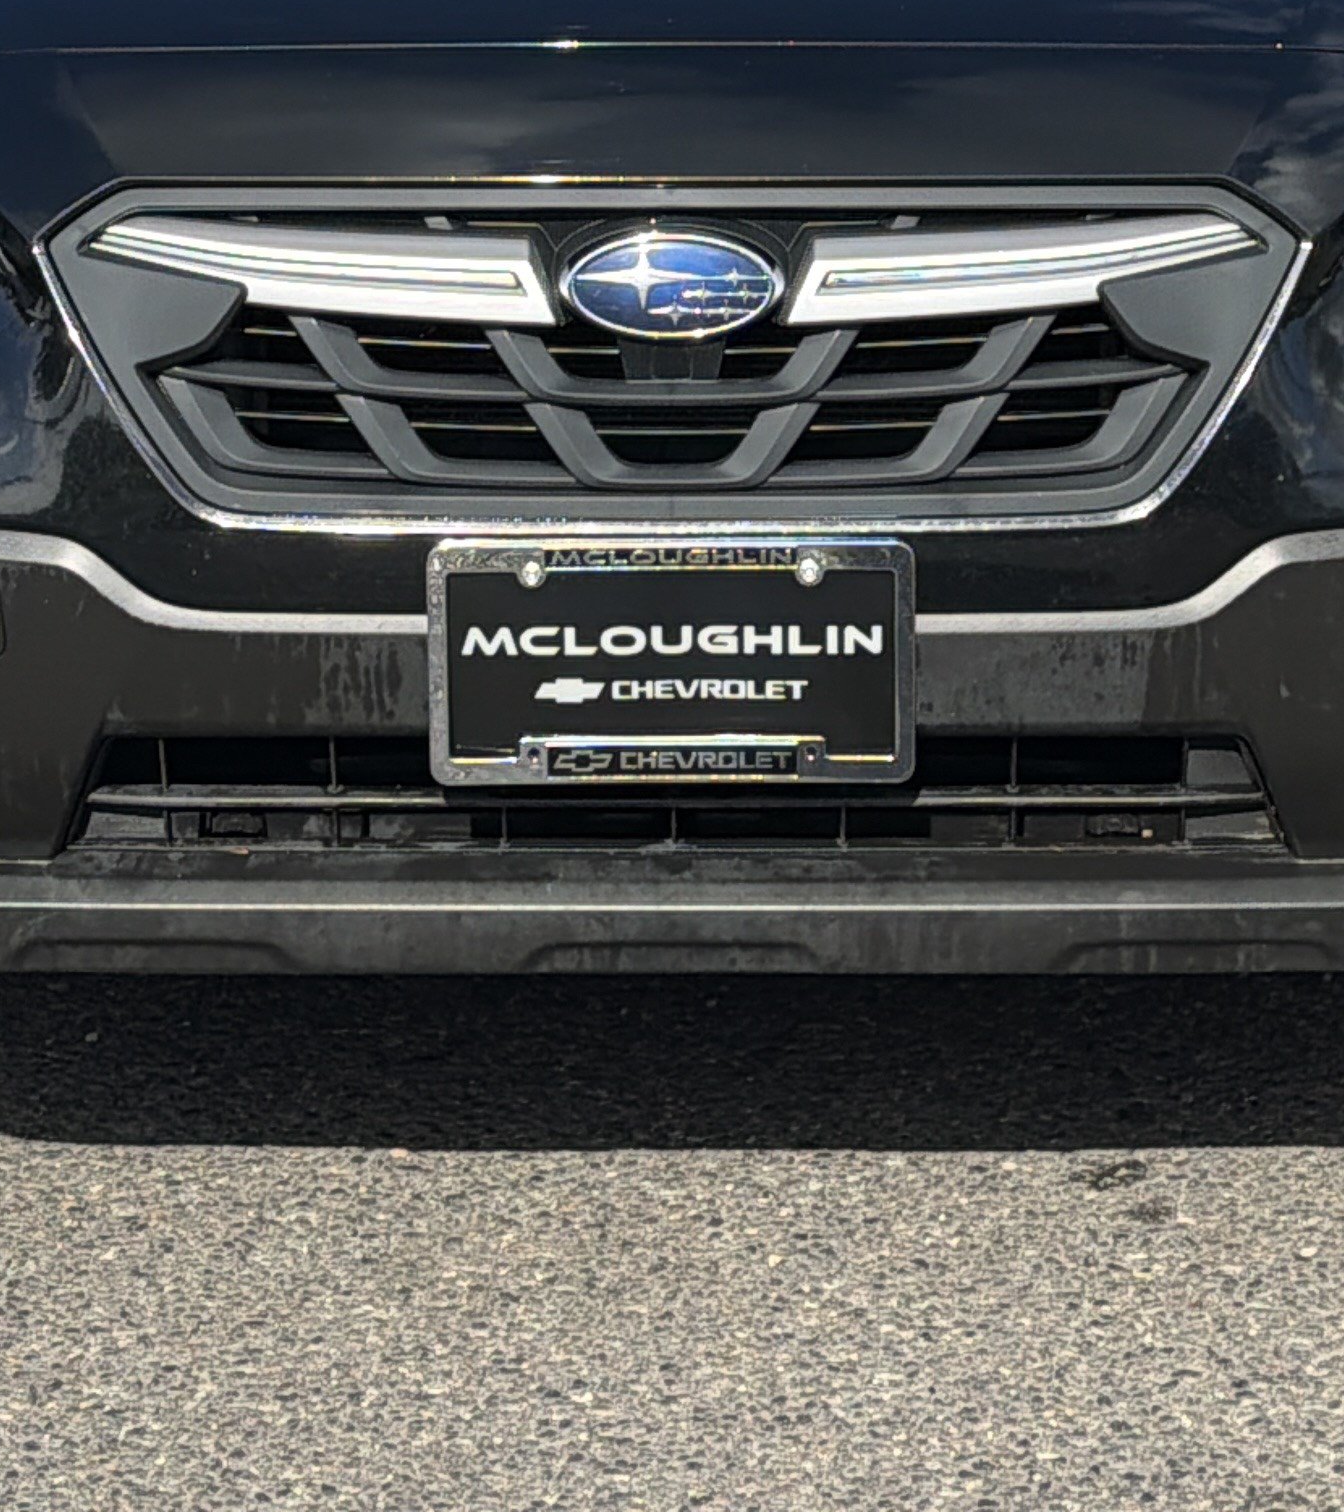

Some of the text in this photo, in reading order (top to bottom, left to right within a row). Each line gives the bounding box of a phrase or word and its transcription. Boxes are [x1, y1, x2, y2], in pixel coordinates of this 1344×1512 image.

[550, 549, 793, 566] MCLOUGHLIN
[460, 625, 884, 656] MCLOUGHLIN
[611, 678, 809, 701] CHEVROLET
[619, 750, 793, 771] CHEVROLET
